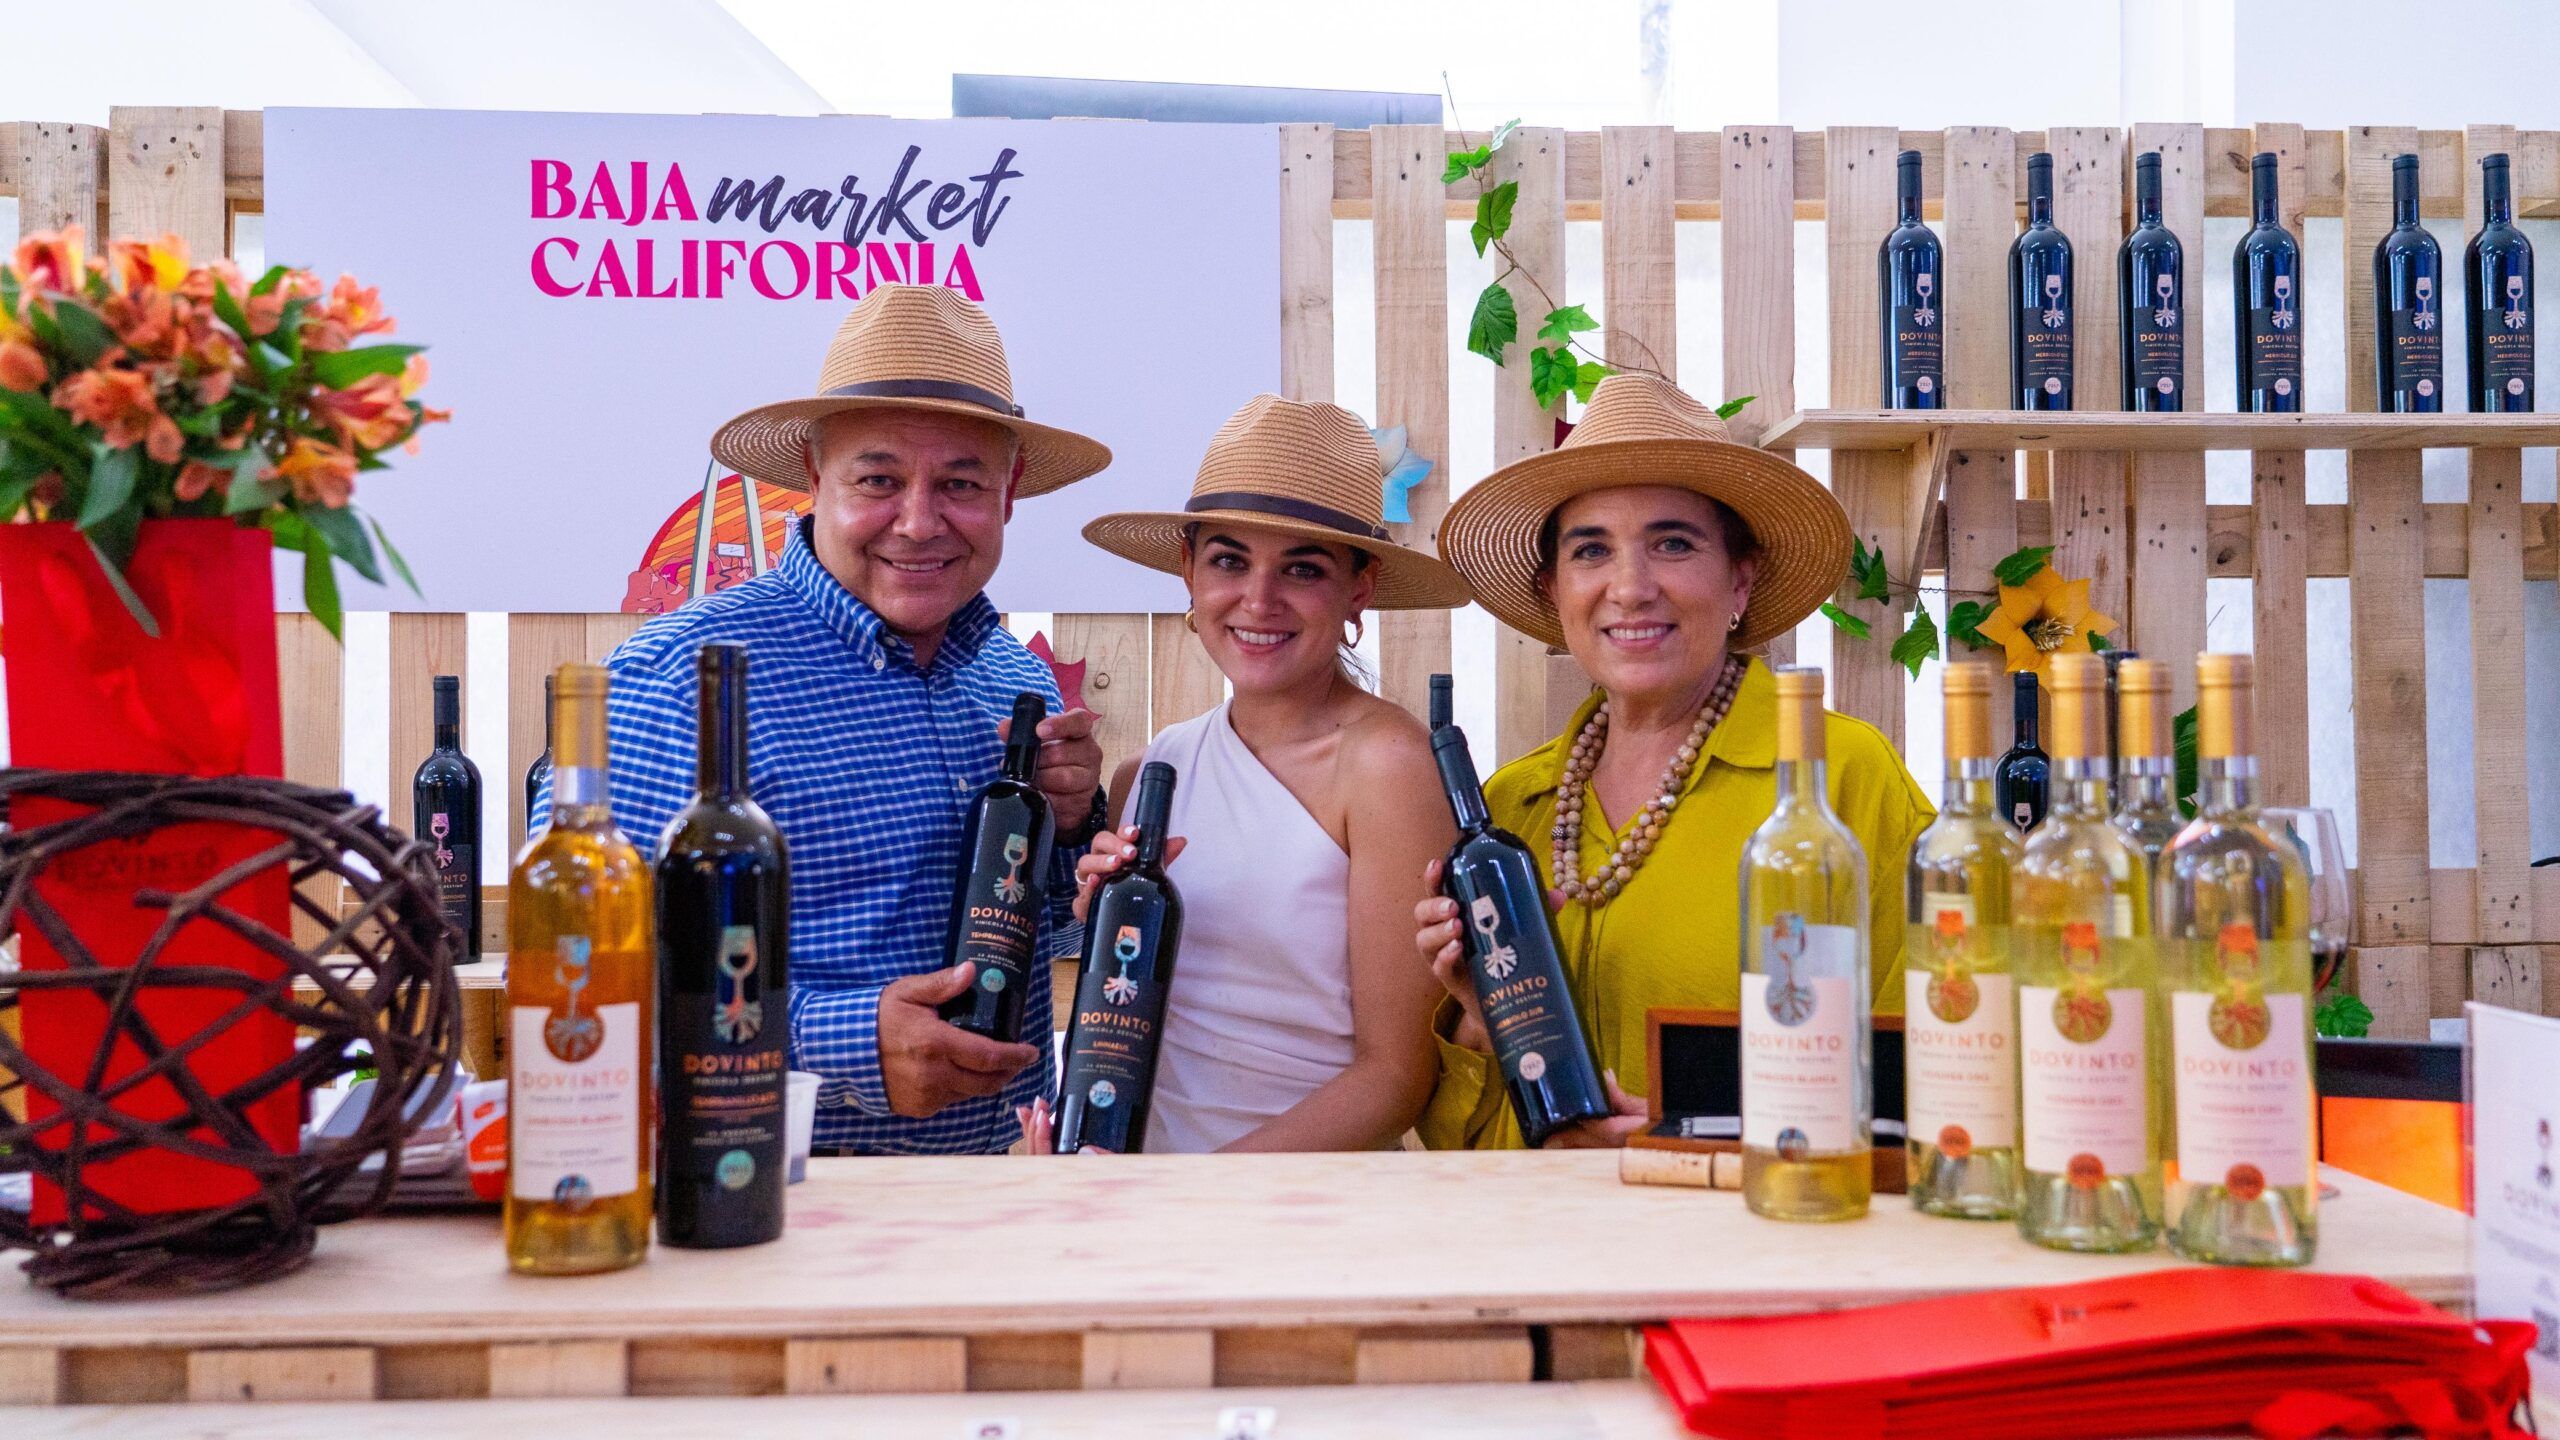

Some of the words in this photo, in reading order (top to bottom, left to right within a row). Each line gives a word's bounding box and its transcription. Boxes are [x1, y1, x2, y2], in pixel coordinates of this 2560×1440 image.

[530, 159, 699, 226] BAJA
[705, 145, 1025, 248] market
[530, 236, 986, 302] CALIFORNIA
[1900, 332, 1941, 342] DOVINT
[2028, 333, 2072, 343] DOVINT
[2140, 333, 2181, 343] DOVINT
[2256, 334, 2297, 344] DOVINT
[2398, 335, 2439, 345] DOVINT
[2488, 333, 2532, 344] DOVINT
[970, 906, 1035, 934] DOVINTO
[1080, 1011, 1151, 1034] DOVINTO
[1748, 1031, 1842, 1052] DOVINTO
[1909, 1027, 2005, 1050] DOVINTO
[683, 1050, 784, 1075] DOVINTO
[2030, 1050, 2137, 1070] DOVINTO
[2184, 1056, 2297, 1079] DOVINTO
[520, 1069, 631, 1090] DOVINTO
